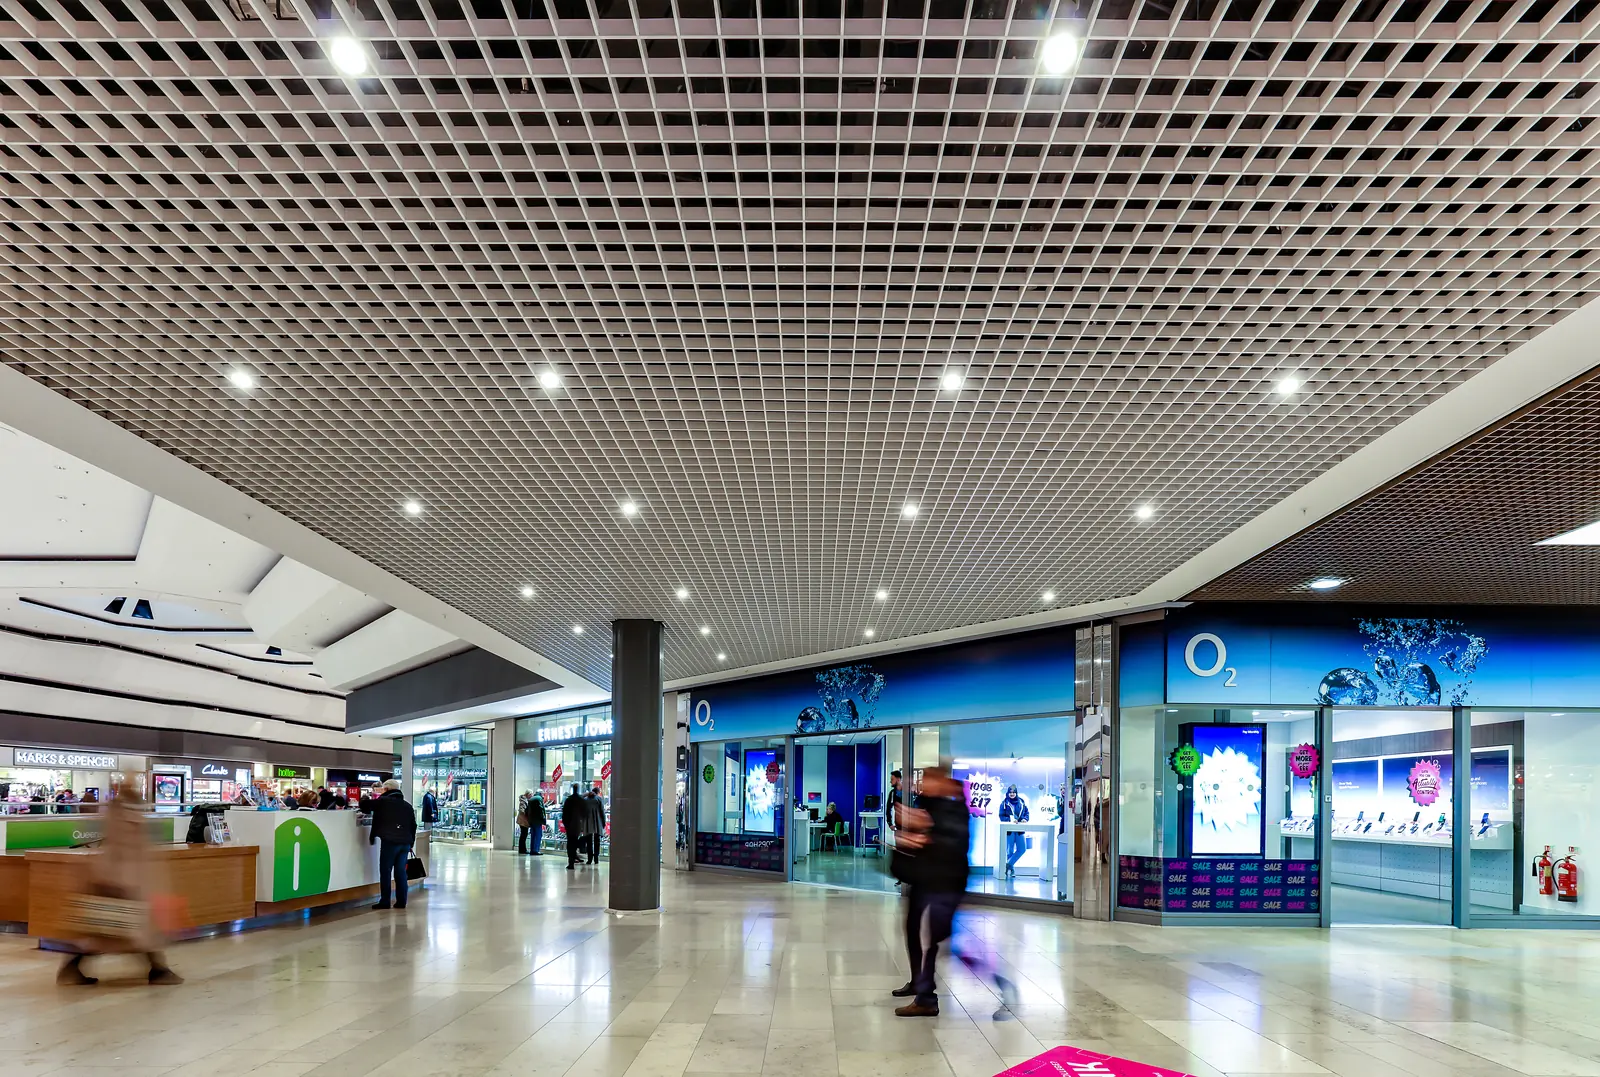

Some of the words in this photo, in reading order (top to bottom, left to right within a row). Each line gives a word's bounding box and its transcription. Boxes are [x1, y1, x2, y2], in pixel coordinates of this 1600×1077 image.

[538, 724, 579, 742] ERNEST
[584, 719, 614, 736] JONE
[438, 740, 460, 752] JONES
[16, 752, 57, 764] MARKS
[58, 754, 66, 765] &
[68, 754, 115, 768] SPENCER
[202, 764, 228, 775] Clarks
[970, 797, 991, 808] £17
[1168, 862, 1188, 870] SALE
[1192, 862, 1211, 870] SALE
[1216, 862, 1235, 871] SALE
[1240, 863, 1259, 871] SALE
[1263, 863, 1282, 871] SALE
[1168, 874, 1188, 882] SALE
[1192, 875, 1211, 883] SALE
[1216, 875, 1235, 883] SALE
[1168, 887, 1188, 895] SALE
[1192, 888, 1211, 896] SALE
[1216, 888, 1235, 896] SALE
[1240, 888, 1259, 896] SALE
[1263, 888, 1282, 897] SALE
[1288, 889, 1306, 897] SALE
[1168, 900, 1188, 908] SALE
[1192, 900, 1211, 908] SALE
[1216, 901, 1235, 909] SALE
[1240, 901, 1259, 909] SALE
[1263, 901, 1282, 909] SALE
[1288, 902, 1306, 910] SALE
